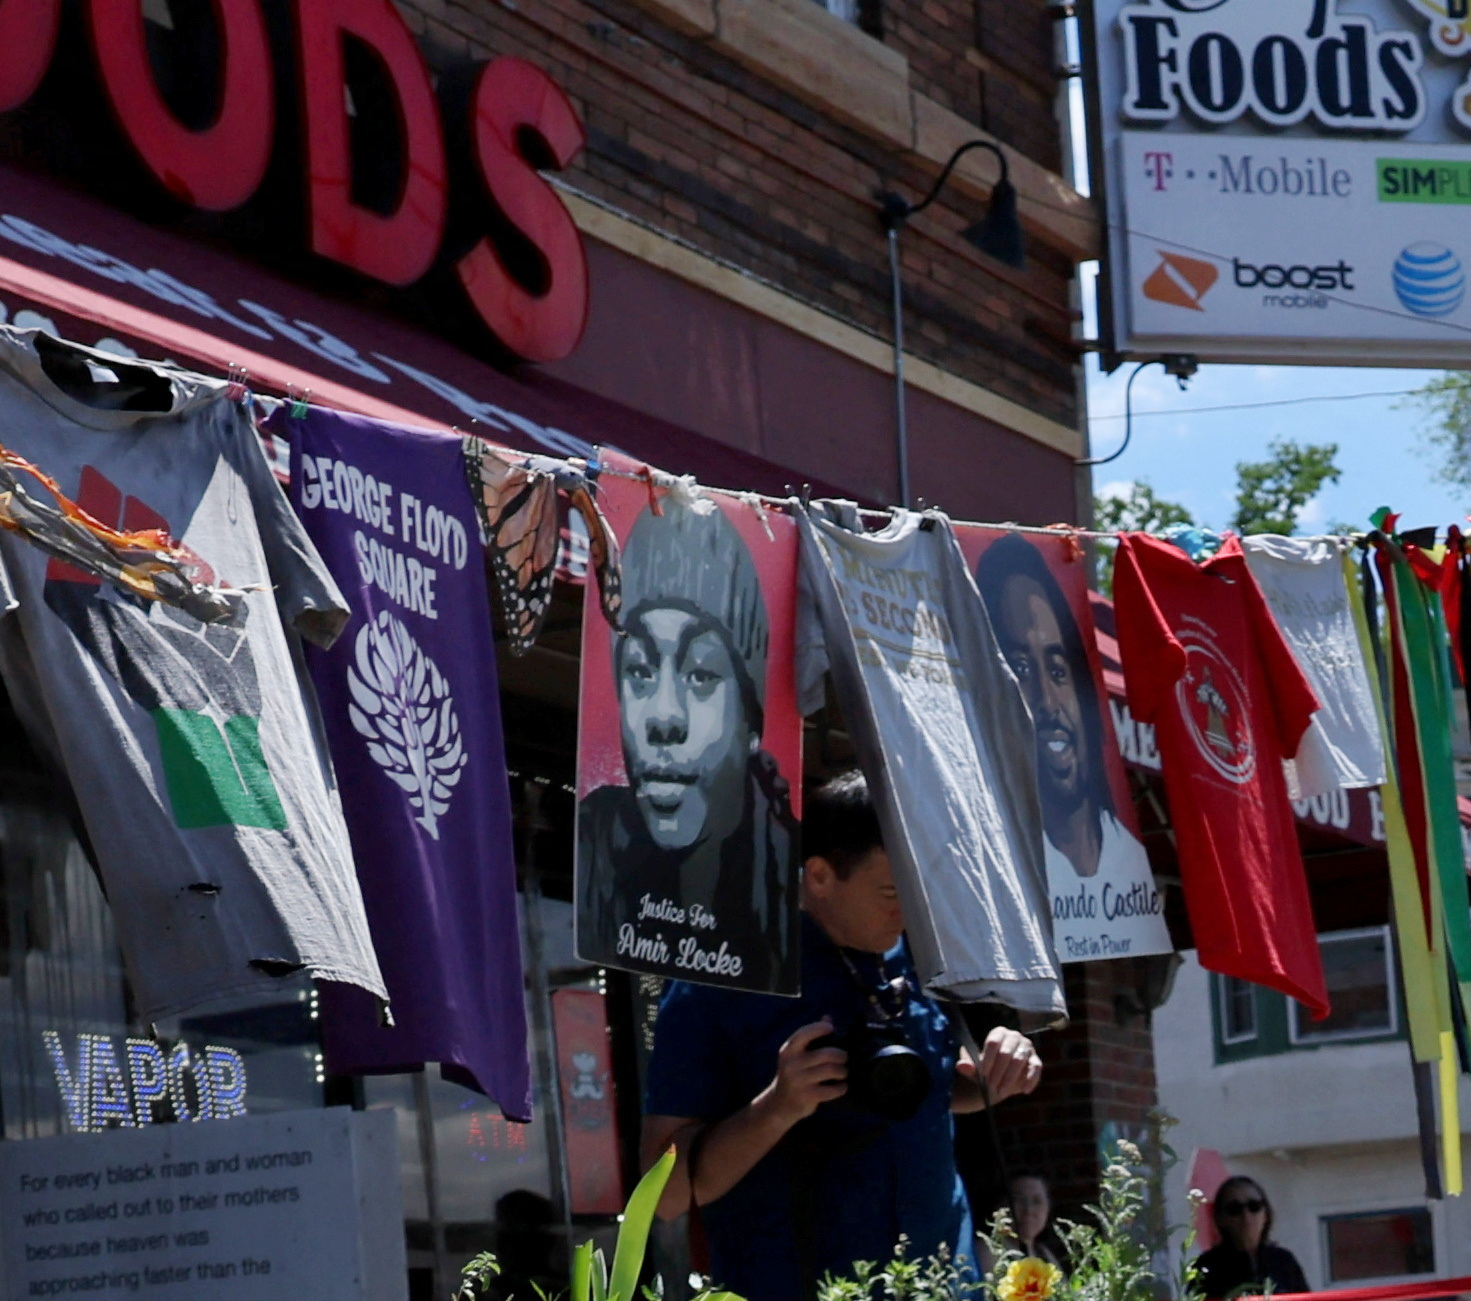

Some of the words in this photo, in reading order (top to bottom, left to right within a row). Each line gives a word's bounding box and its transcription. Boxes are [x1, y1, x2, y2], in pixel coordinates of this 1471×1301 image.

[1127, 15, 1421, 120] Foods
[1233, 257, 1355, 291] boost
[1263, 293, 1328, 309] mobile
[300, 453, 394, 535] GEORGE
[401, 490, 468, 571] FLOYD
[359, 531, 439, 620] SQUARE
[638, 892, 684, 927] Justice
[1102, 882, 1161, 921] Castile
[617, 922, 672, 968] Amir
[675, 940, 744, 978] Locke
[43, 1030, 248, 1132] VAPOR
[21, 1173, 49, 1193] For
[54, 1168, 102, 1194] every
[107, 1160, 155, 1186] black
[160, 1160, 200, 1179] man
[205, 1153, 241, 1175] and
[246, 1149, 313, 1171] woman
[23, 1207, 60, 1230] who
[65, 1199, 117, 1224] called
[124, 1199, 151, 1219] out
[157, 1197, 174, 1216] to
[180, 1190, 218, 1214] their
[224, 1185, 301, 1210] mothers
[26, 1236, 102, 1262] because
[107, 1231, 169, 1256] heaven
[174, 1231, 210, 1250] was
[29, 1268, 140, 1297] approaching
[144, 1264, 192, 1287] faster
[196, 1260, 237, 1283] than
[243, 1257, 271, 1277] the
